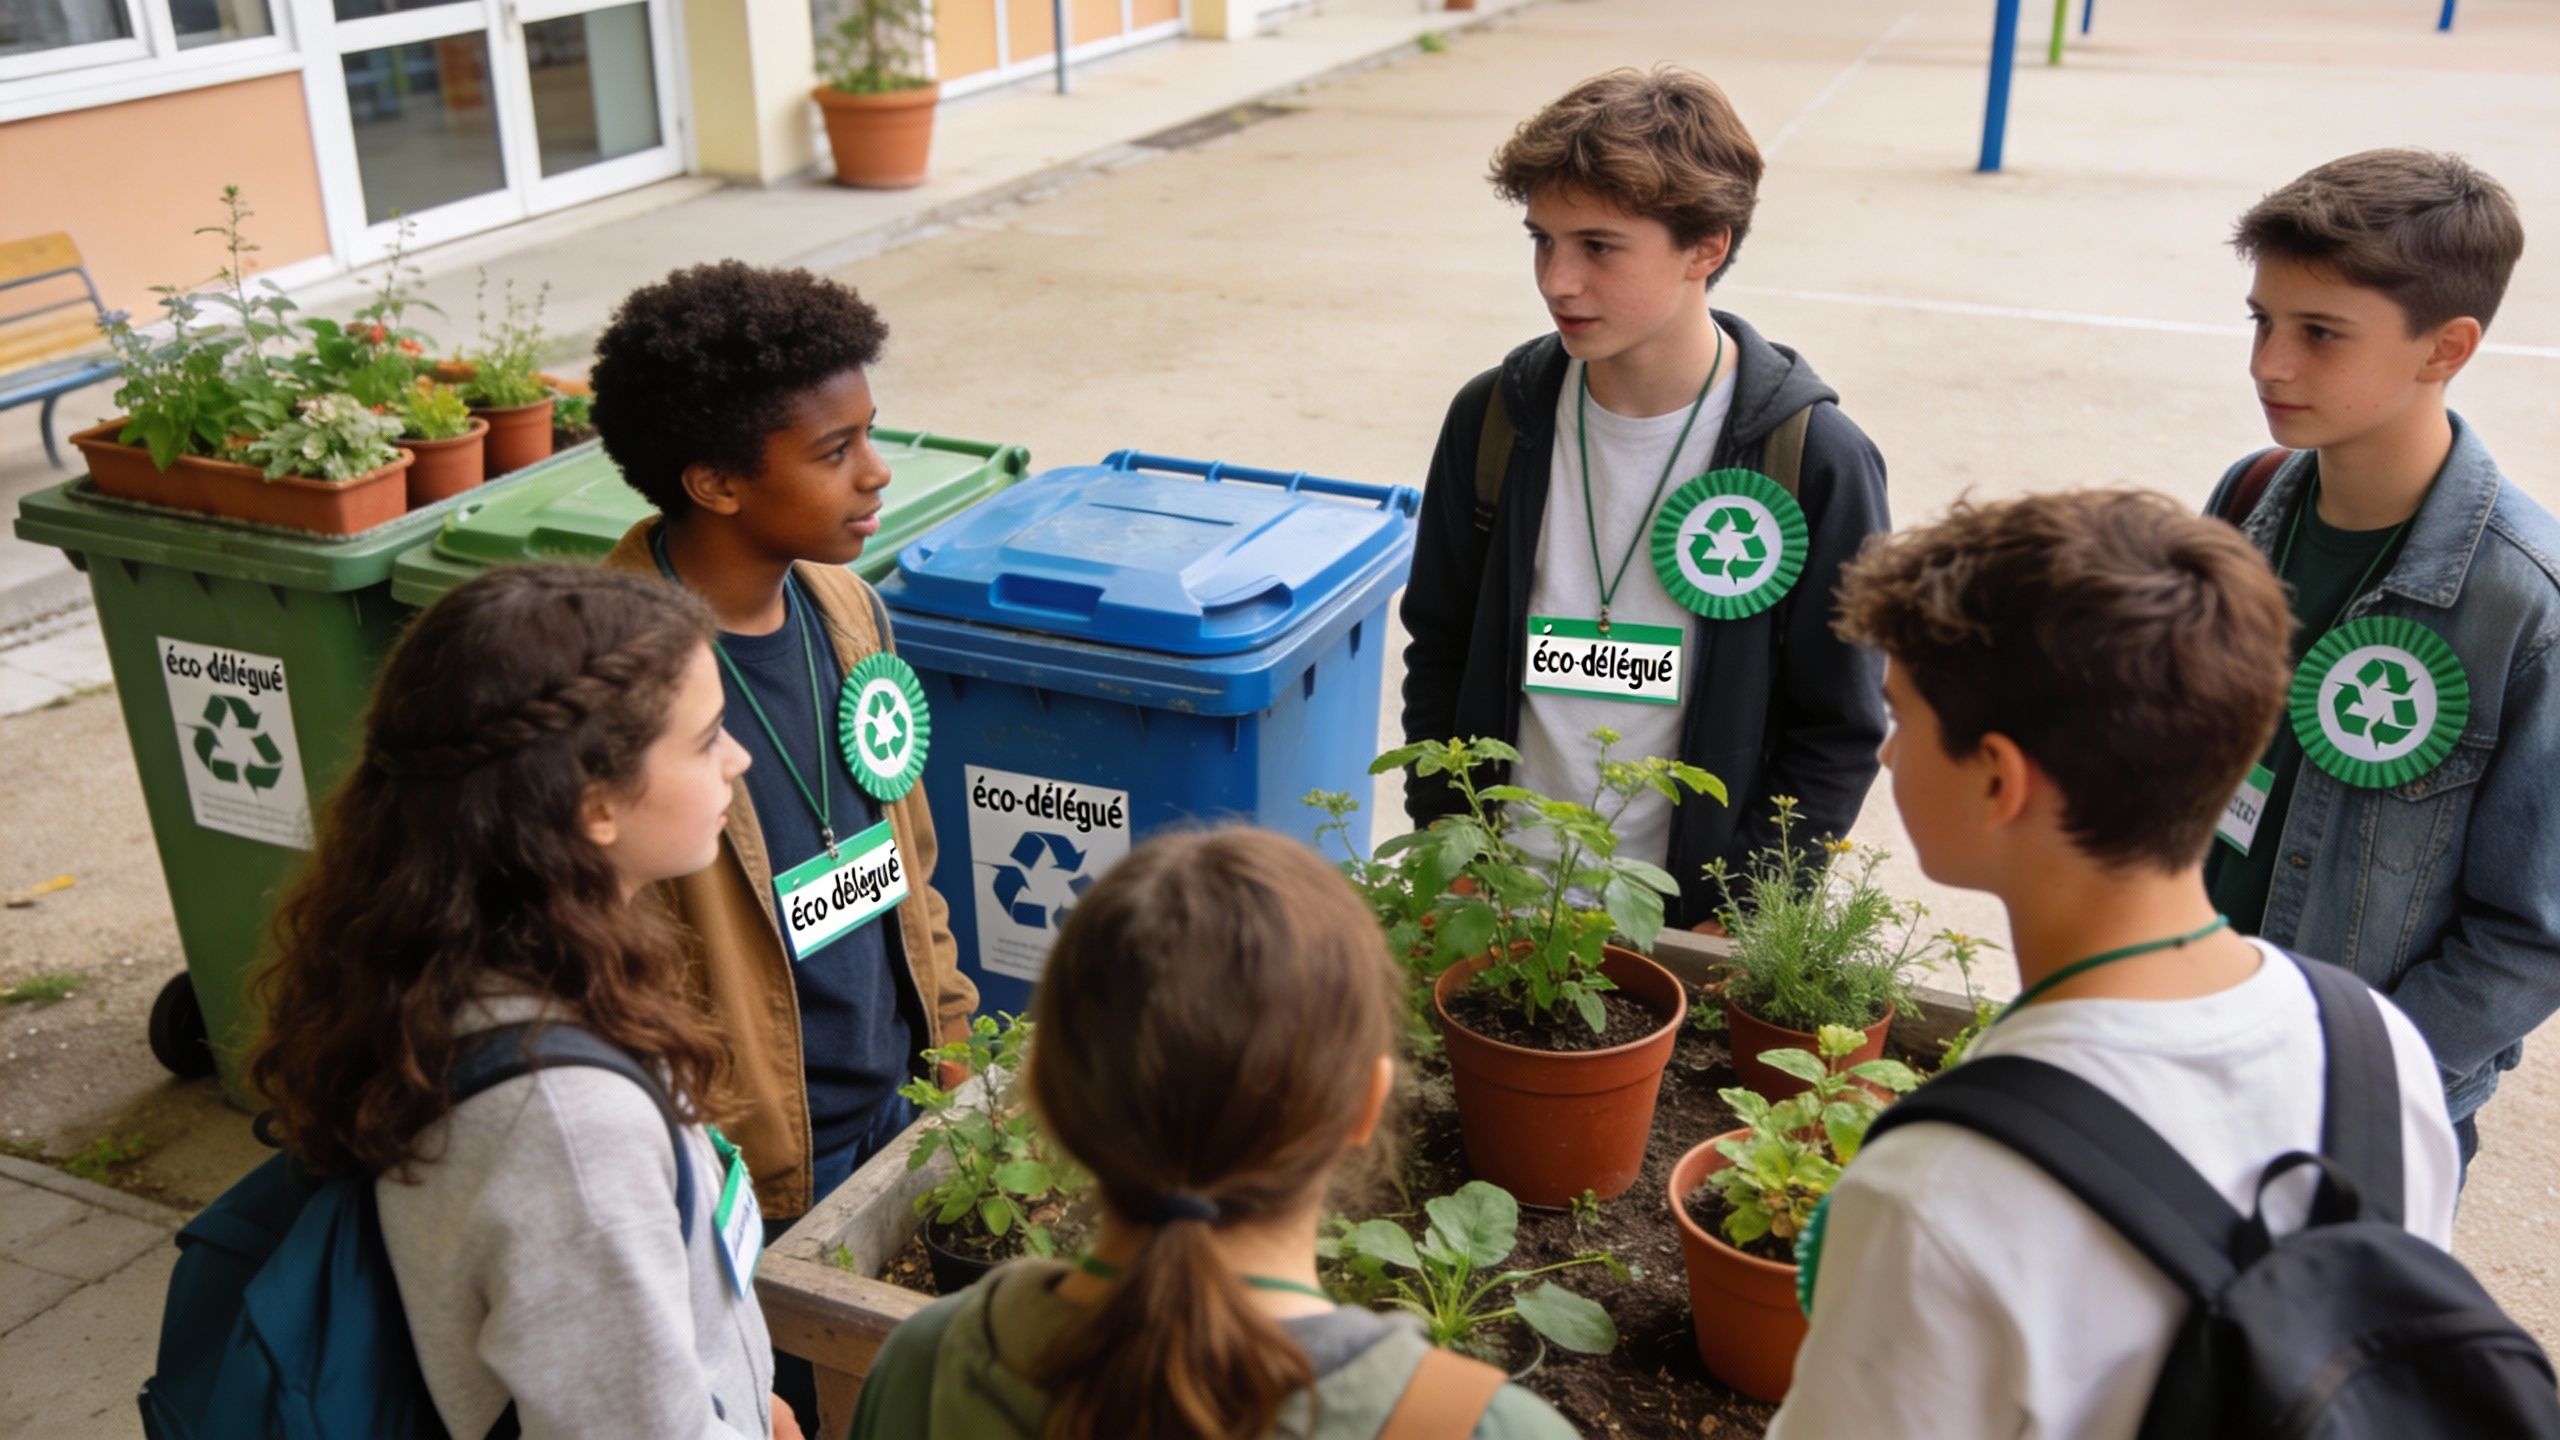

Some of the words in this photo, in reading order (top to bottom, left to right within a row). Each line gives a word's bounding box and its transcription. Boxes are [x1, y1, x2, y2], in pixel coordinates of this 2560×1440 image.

[1533, 640, 1673, 690] éco-délégué
[973, 775, 1123, 832] éco-délégué
[792, 896, 828, 931] éco
